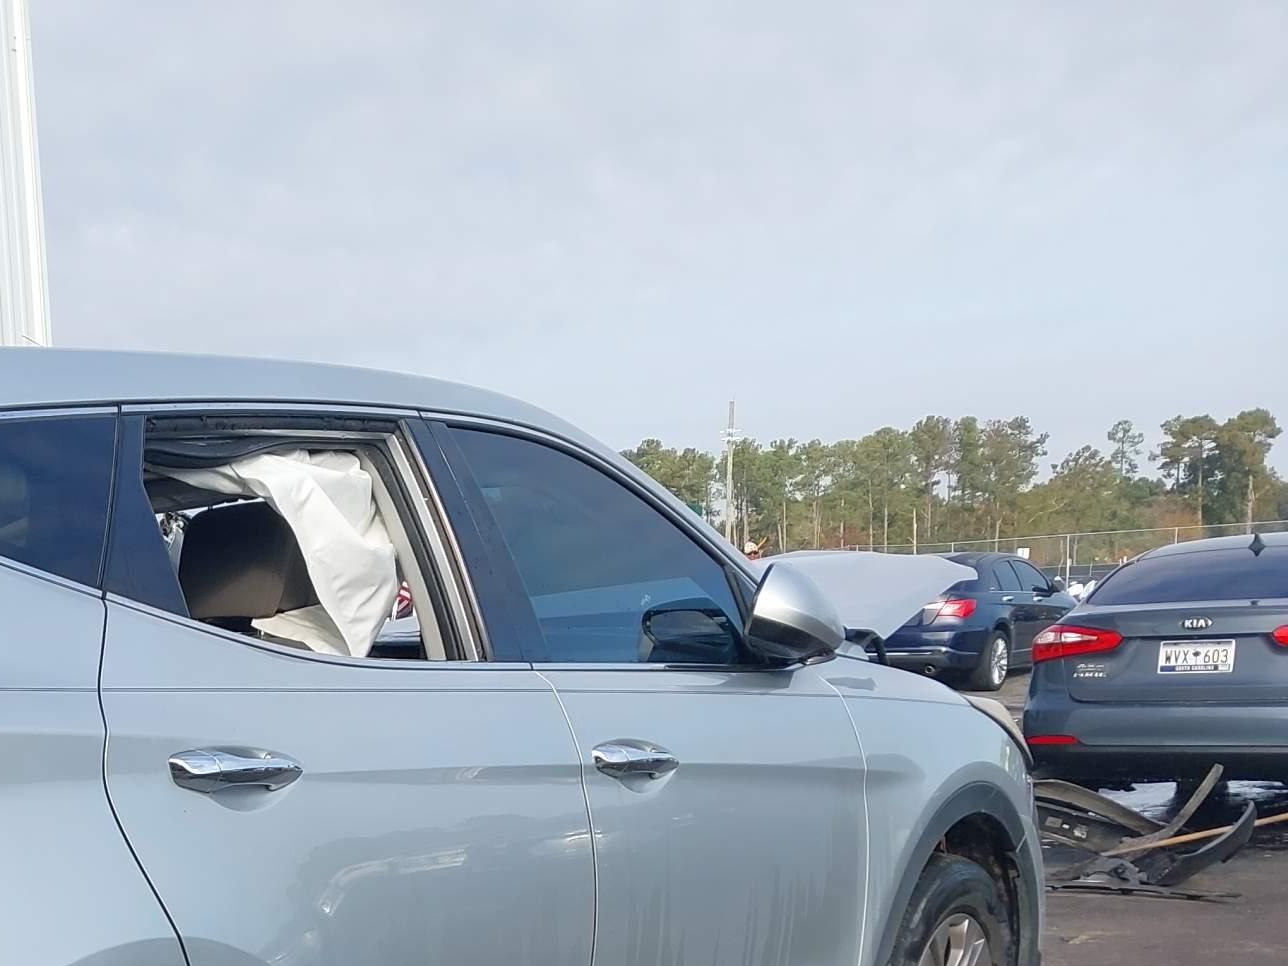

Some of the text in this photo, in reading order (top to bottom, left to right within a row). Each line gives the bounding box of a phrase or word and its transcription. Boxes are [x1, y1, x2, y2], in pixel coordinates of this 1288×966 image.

[1184, 619, 1206, 628] KIA
[1165, 648, 1228, 664] WVX 603
